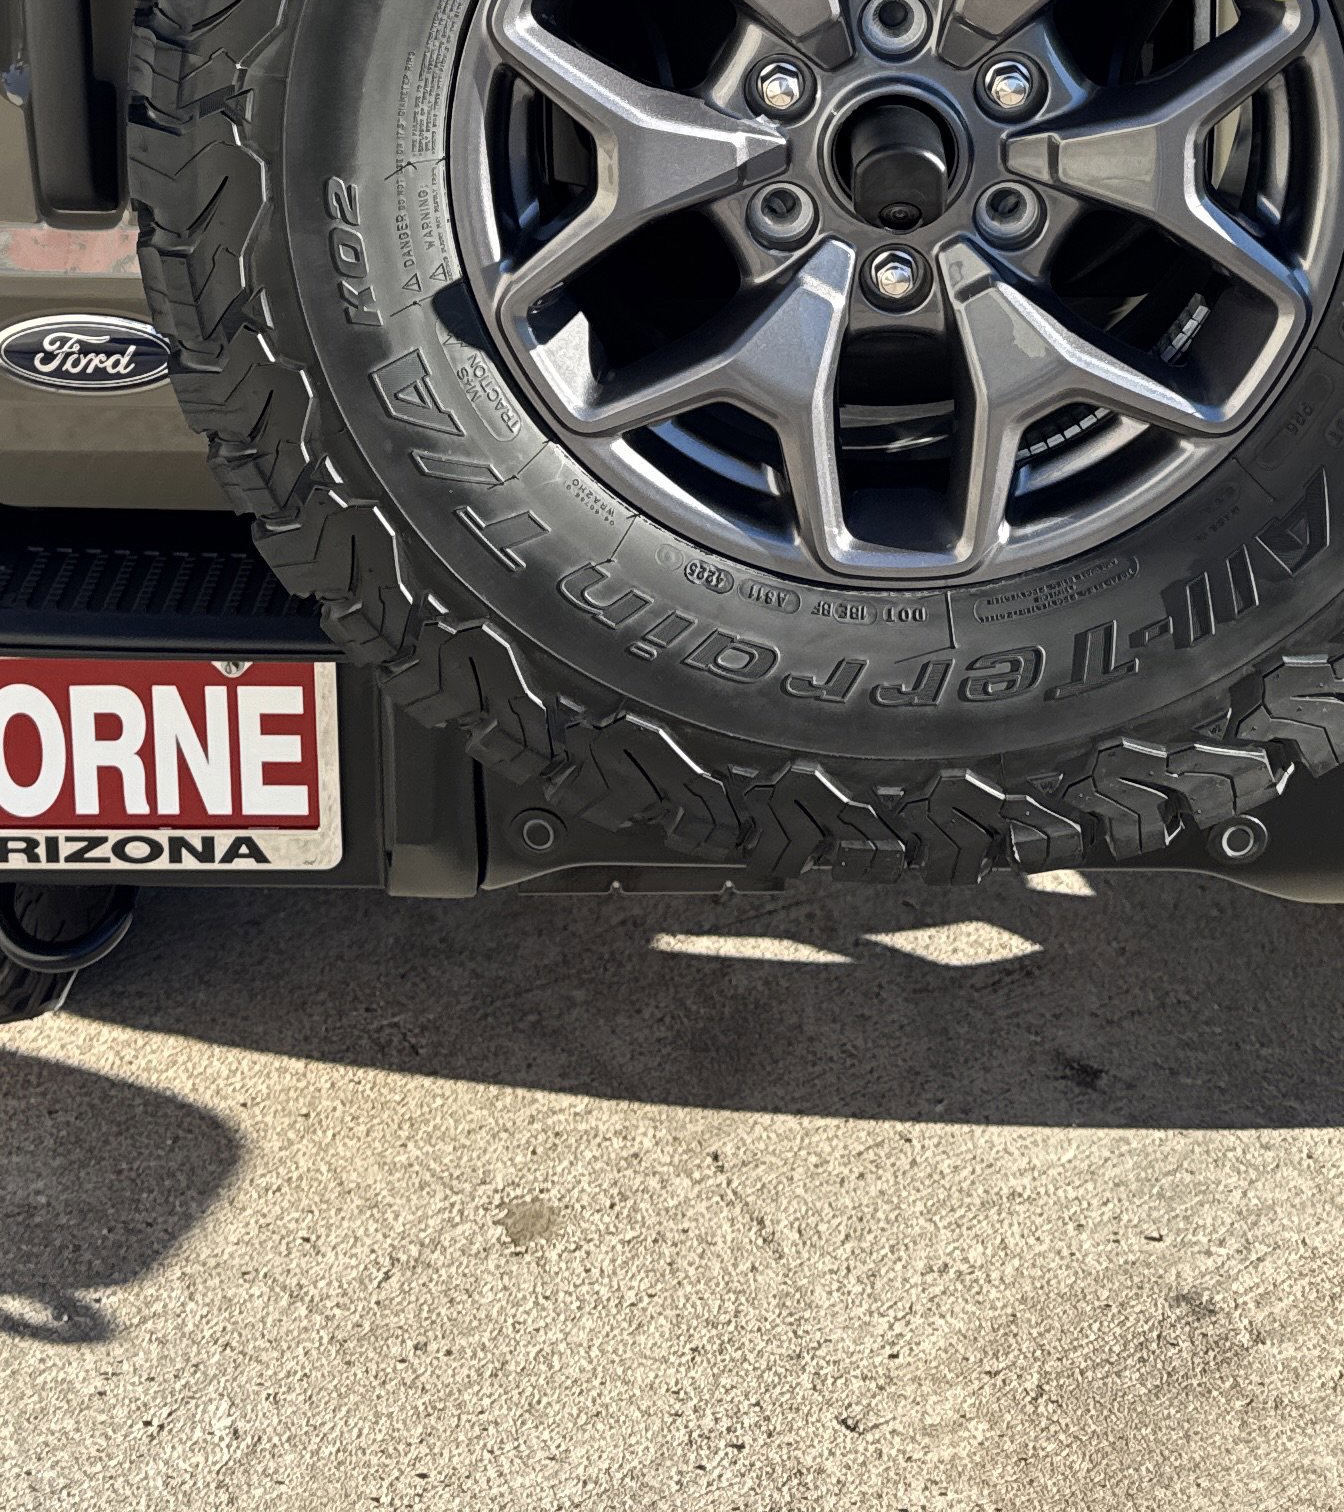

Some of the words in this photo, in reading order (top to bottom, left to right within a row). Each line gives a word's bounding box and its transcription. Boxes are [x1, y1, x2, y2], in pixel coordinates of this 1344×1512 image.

[325, 175, 385, 326] KO2
[395, 213, 416, 270] DANGER
[34, 332, 136, 376] Ford
[466, 351, 521, 434] TRACTION
[368, 348, 553, 573] T/A
[559, 464, 1330, 709] All-Terrain
[881, 604, 929, 624] DOT
